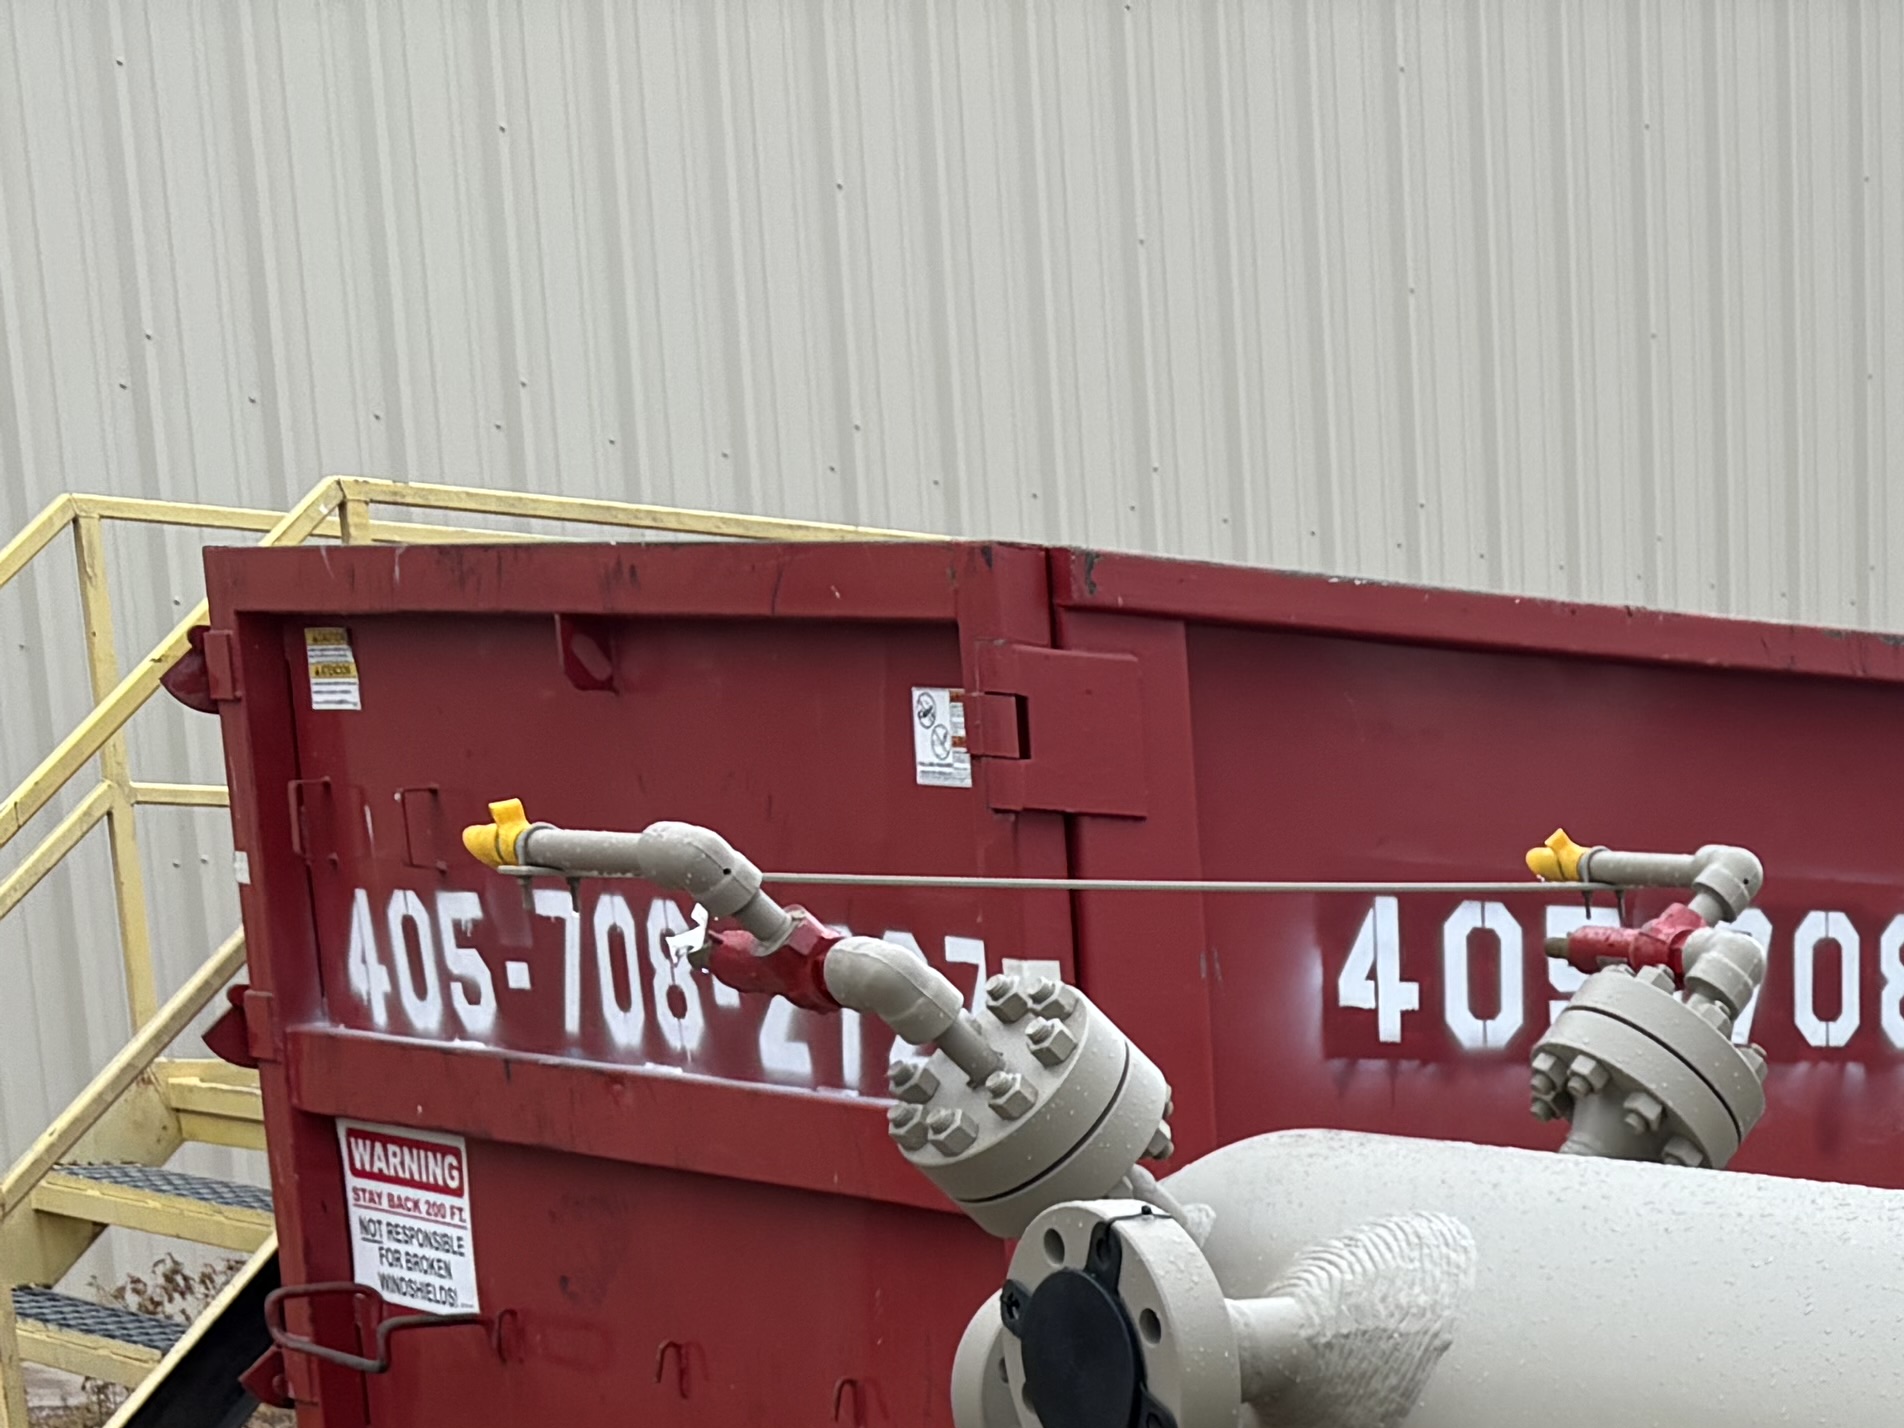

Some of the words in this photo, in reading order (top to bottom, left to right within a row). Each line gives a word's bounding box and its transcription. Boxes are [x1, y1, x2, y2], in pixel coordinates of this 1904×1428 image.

[349, 1137, 461, 1189] WARNING
[351, 1186, 382, 1206] STAY
[387, 1192, 421, 1214] BACK
[424, 1199, 446, 1219] 200
[359, 1216, 383, 1239] NOT
[386, 1221, 465, 1257] RESPONSIBLE
[378, 1246, 403, 1269] FOR
[405, 1251, 453, 1280] BROKEN
